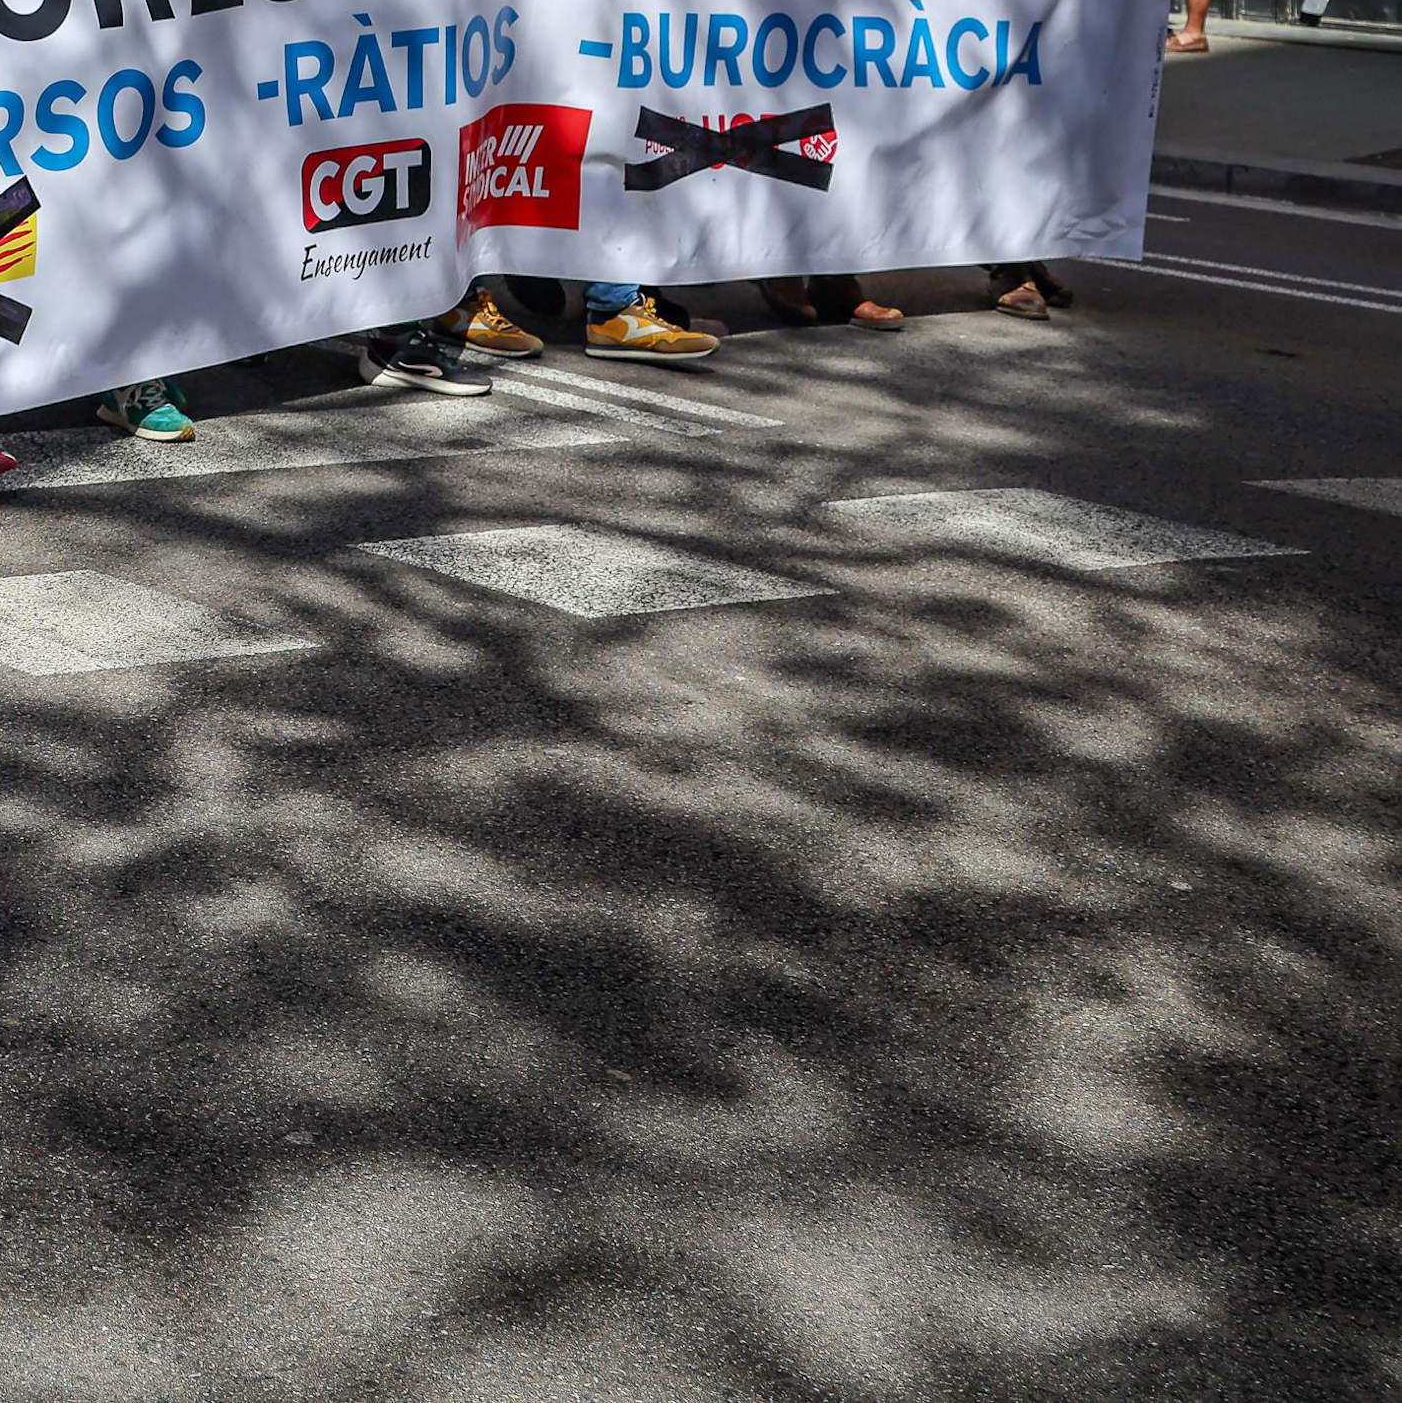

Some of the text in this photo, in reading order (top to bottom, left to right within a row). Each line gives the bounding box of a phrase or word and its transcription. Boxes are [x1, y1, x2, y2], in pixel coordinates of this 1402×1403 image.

[258, 6, 518, 126] -RÀTIOS
[579, 0, 1042, 90] -BUROCRÀCIA
[309, 149, 423, 223] CGT
[300, 236, 433, 281] Ensenyament
